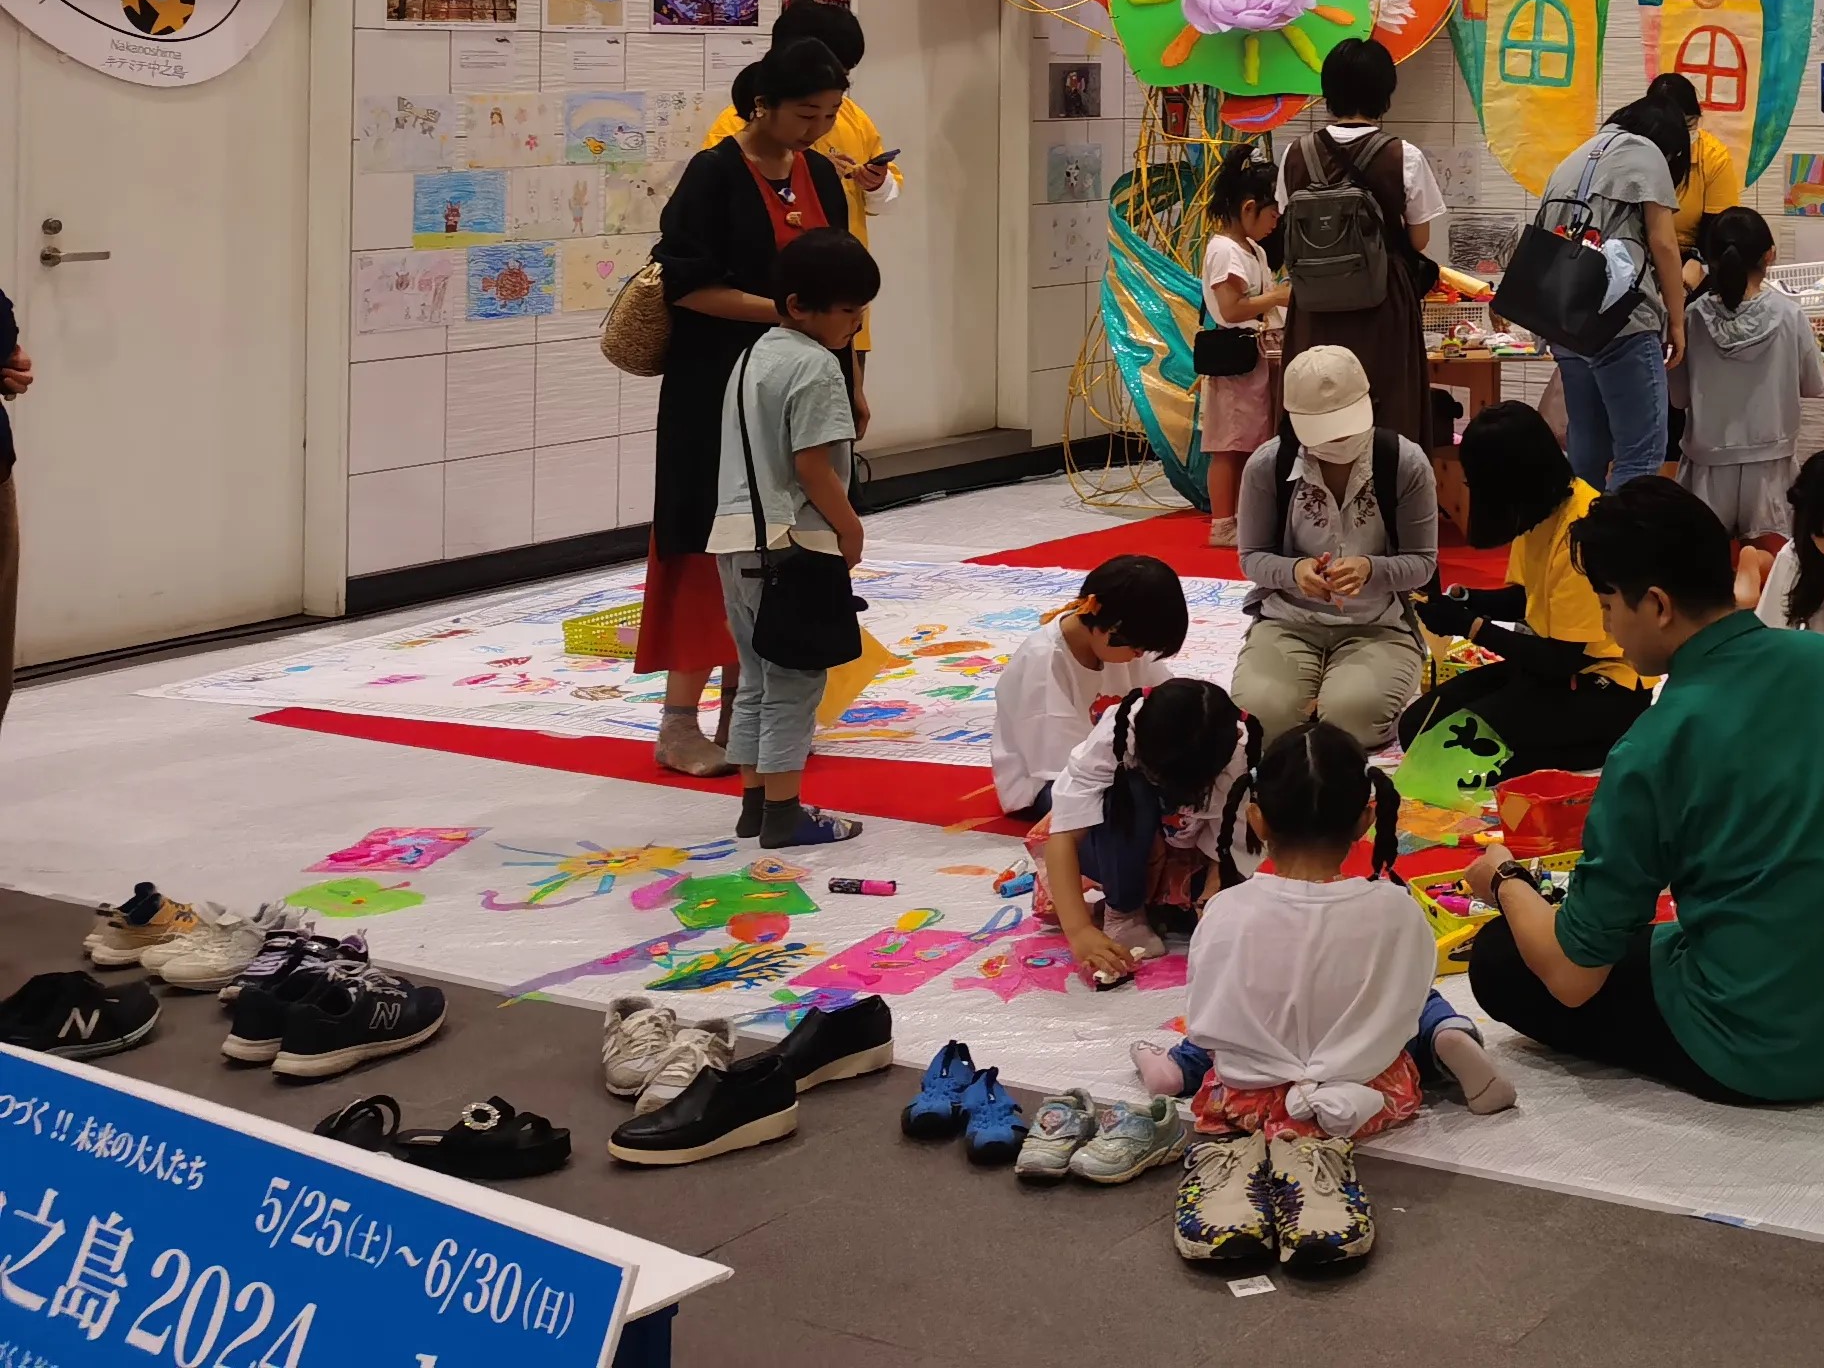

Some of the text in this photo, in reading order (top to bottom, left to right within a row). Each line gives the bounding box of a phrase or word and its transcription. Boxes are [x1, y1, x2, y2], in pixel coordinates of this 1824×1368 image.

[58, 1007, 100, 1039] N
[369, 1001, 401, 1030] N
[0, 1187, 318, 1368] 之島 2024
